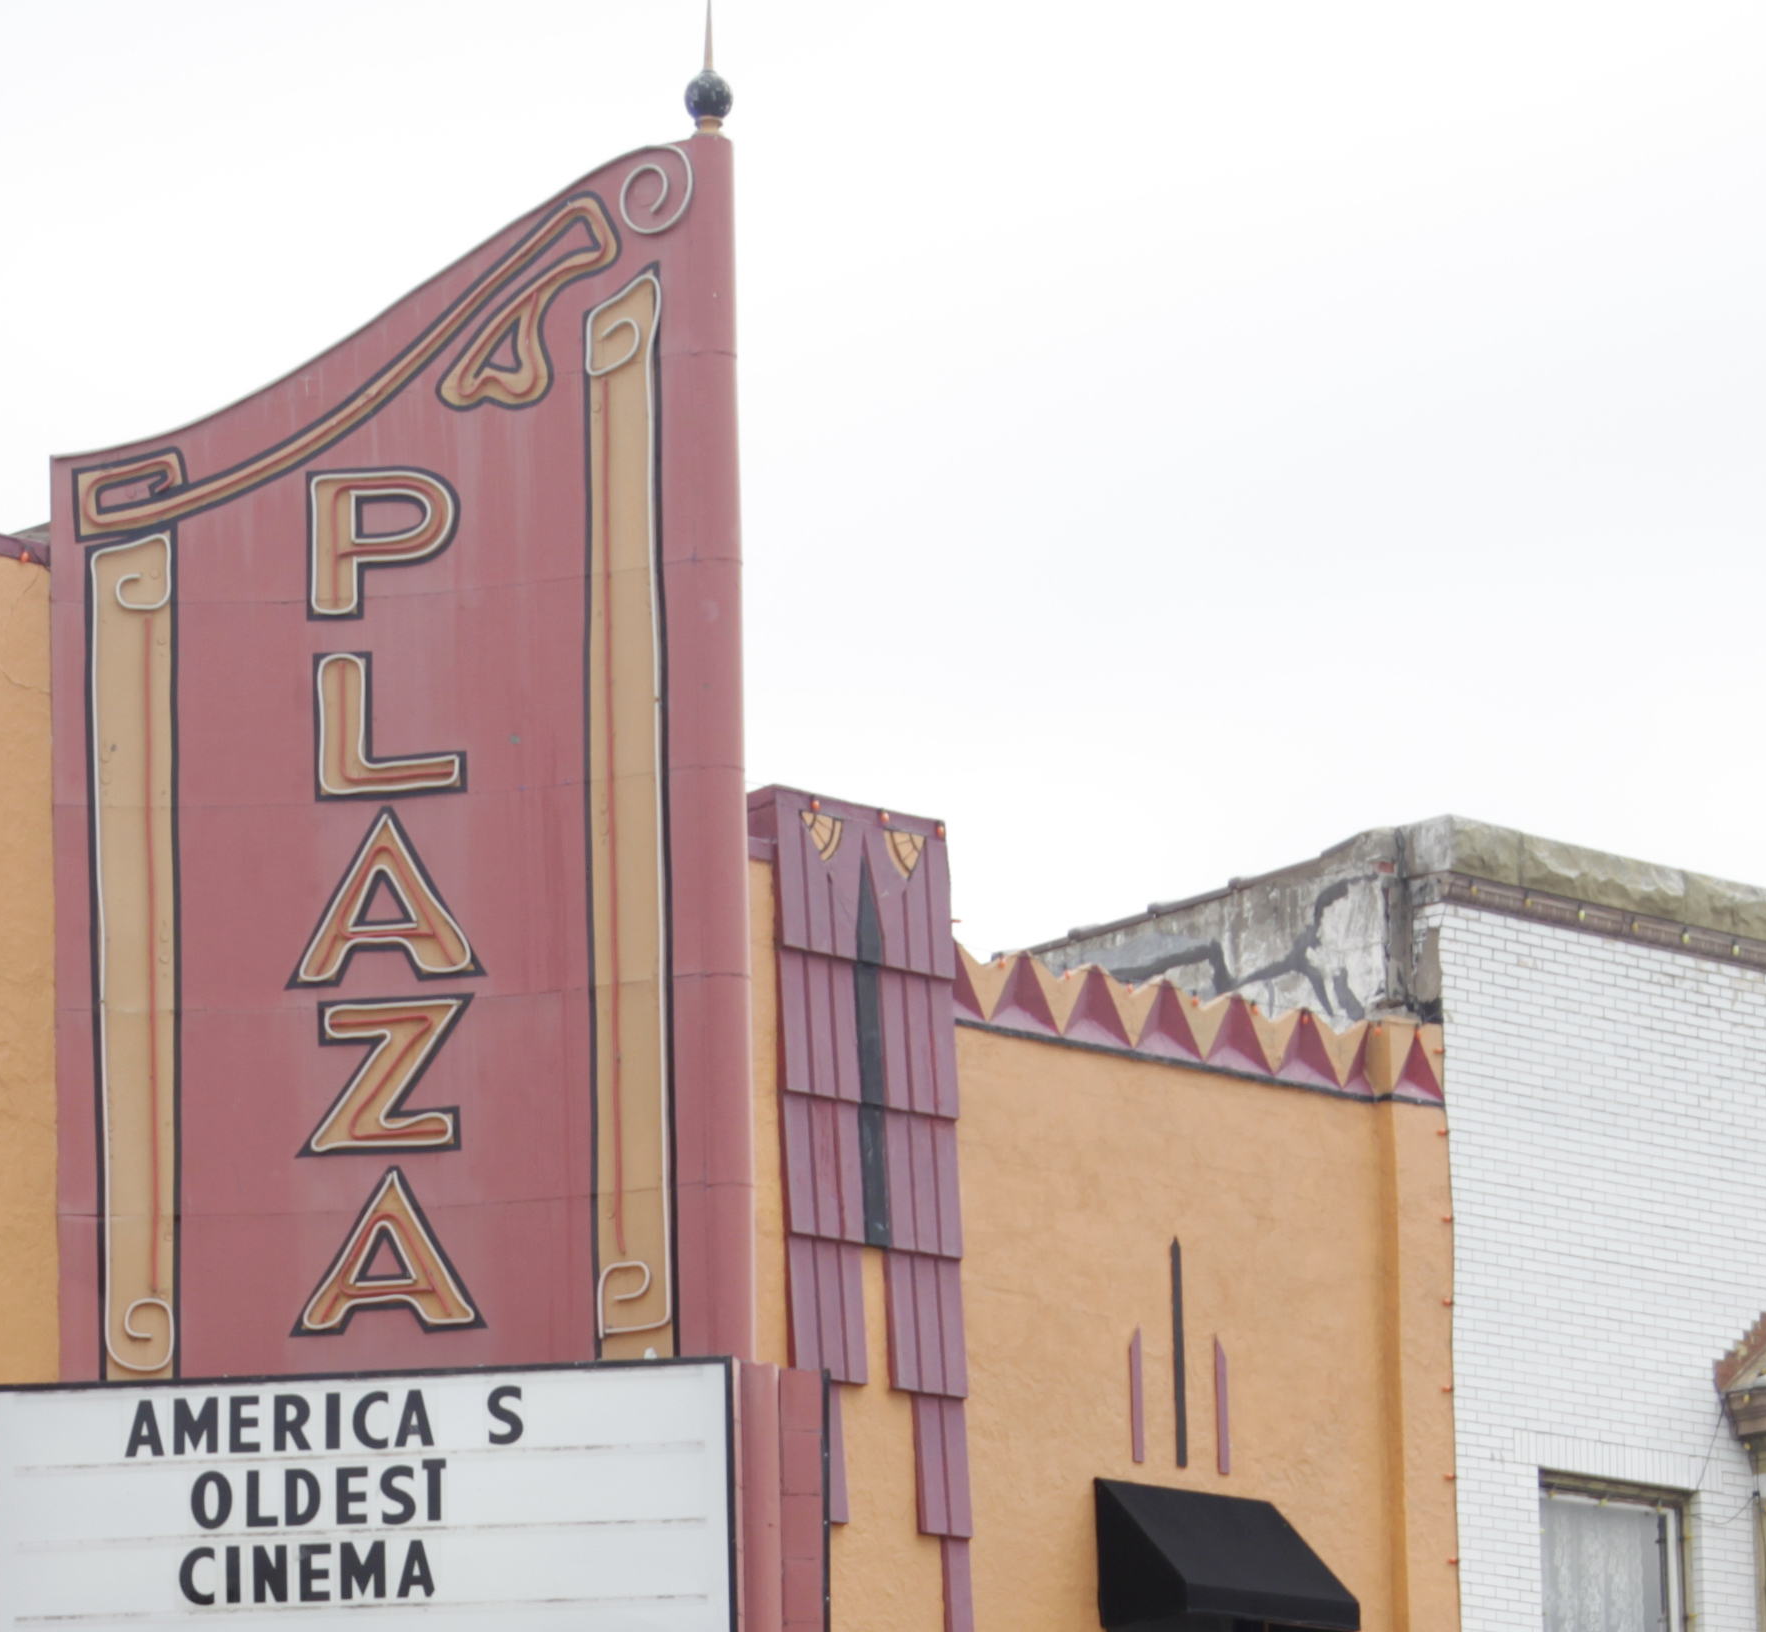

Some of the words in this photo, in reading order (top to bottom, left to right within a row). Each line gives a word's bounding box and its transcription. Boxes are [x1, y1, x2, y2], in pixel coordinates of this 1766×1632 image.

[285, 466, 485, 1336] PLAZA
[125, 1388, 435, 1459] AMERICA
[487, 1385, 525, 1446] S
[190, 1457, 447, 1530] OLDEST
[178, 1539, 436, 1606] CINEMA
